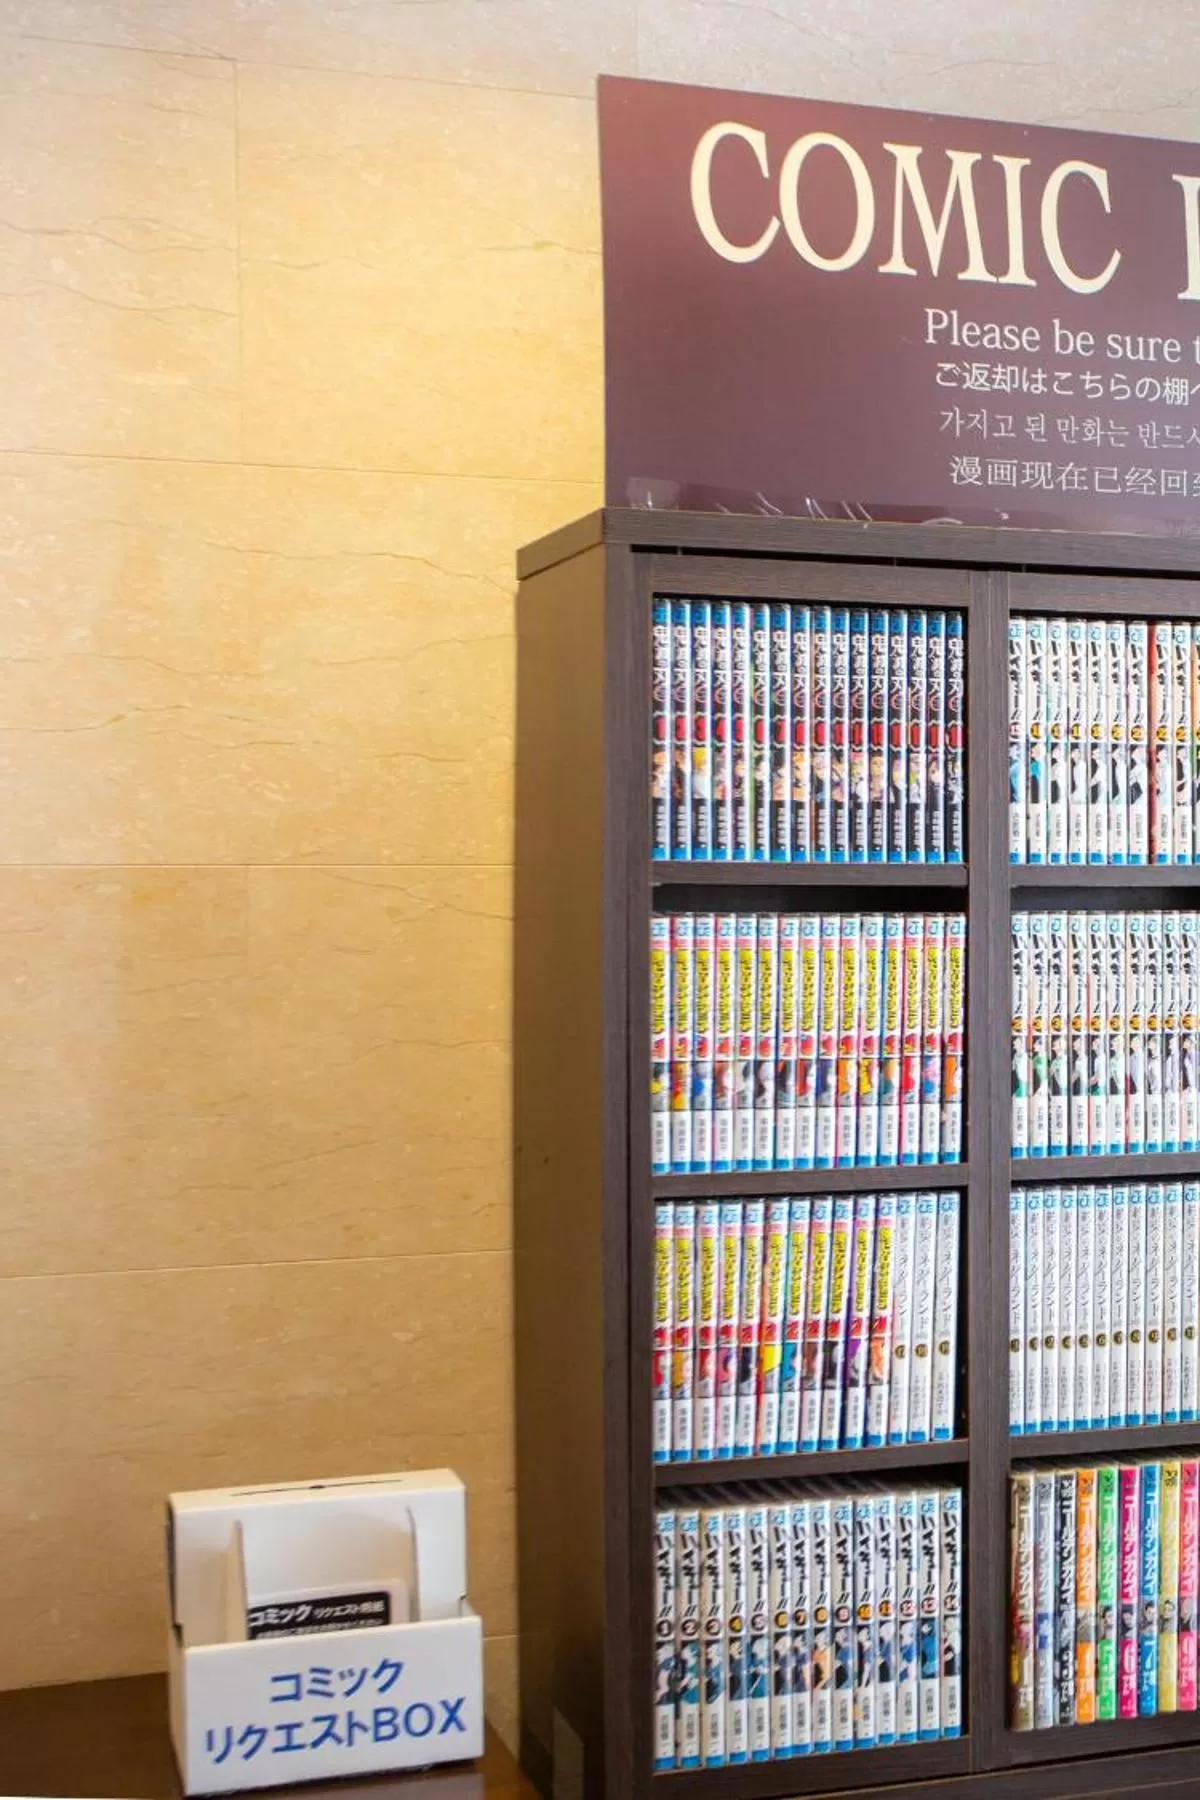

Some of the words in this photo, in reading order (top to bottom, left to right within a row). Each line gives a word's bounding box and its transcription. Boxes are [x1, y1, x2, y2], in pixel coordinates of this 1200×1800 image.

[690, 121, 1122, 295] COMIC
[924, 307, 1041, 352] Please
[1052, 318, 1095, 357] be
[1106, 332, 1182, 363] sure
[940, 405, 1017, 440] 가지고
[1024, 412, 1047, 443] 된
[1056, 415, 1130, 448] 만화는
[249, 1603, 313, 1627] コミック
[270, 1658, 404, 1703] コミック
[206, 1696, 467, 1764] リクエストBOX
